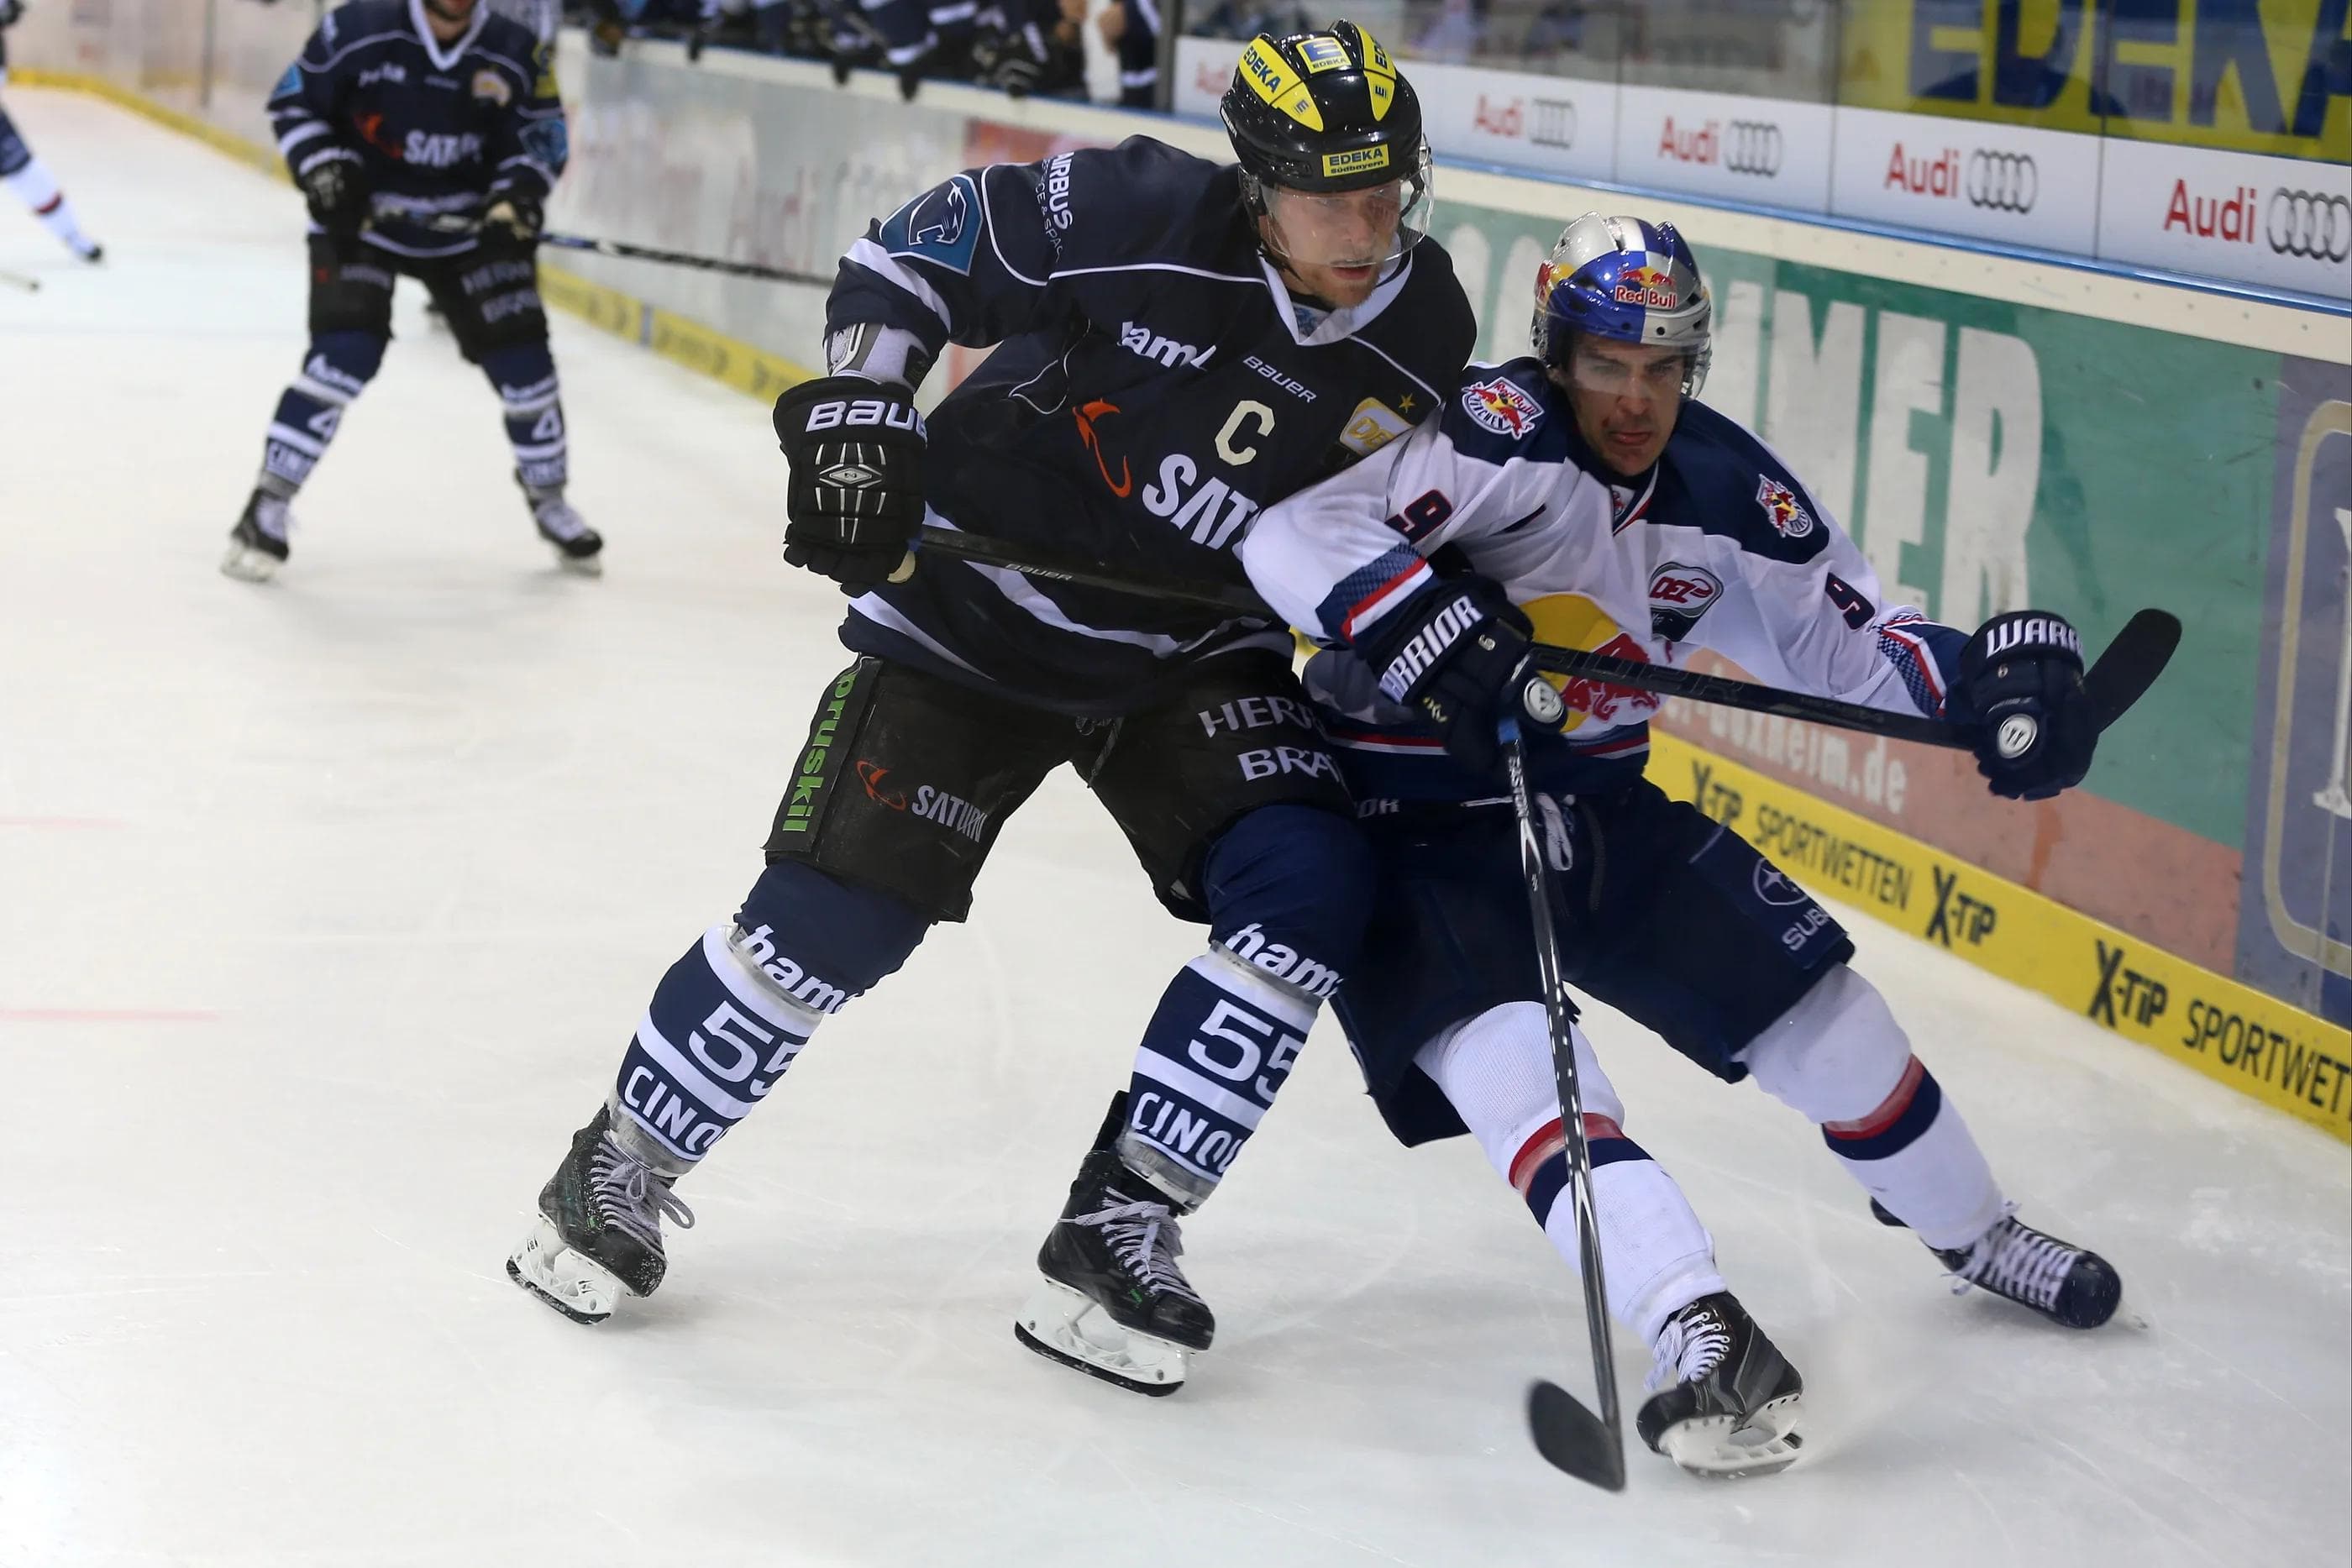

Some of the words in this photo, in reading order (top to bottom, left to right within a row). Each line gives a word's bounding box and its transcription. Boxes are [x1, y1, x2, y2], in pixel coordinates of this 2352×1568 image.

[1313, 57, 1347, 70] EDEKA
[1329, 147, 1383, 166] EDEKA
[1658, 115, 1720, 165] Audi
[1884, 142, 1959, 199] Audi
[2163, 178, 2257, 244] Audi
[1615, 286, 1646, 304] Red
[1648, 289, 1677, 310] Bull
[1242, 355, 1317, 403] BAUER
[1215, 400, 1275, 466] C
[1753, 804, 1914, 910] SPORTWETTEN
[1188, 999, 1306, 1104] 55
